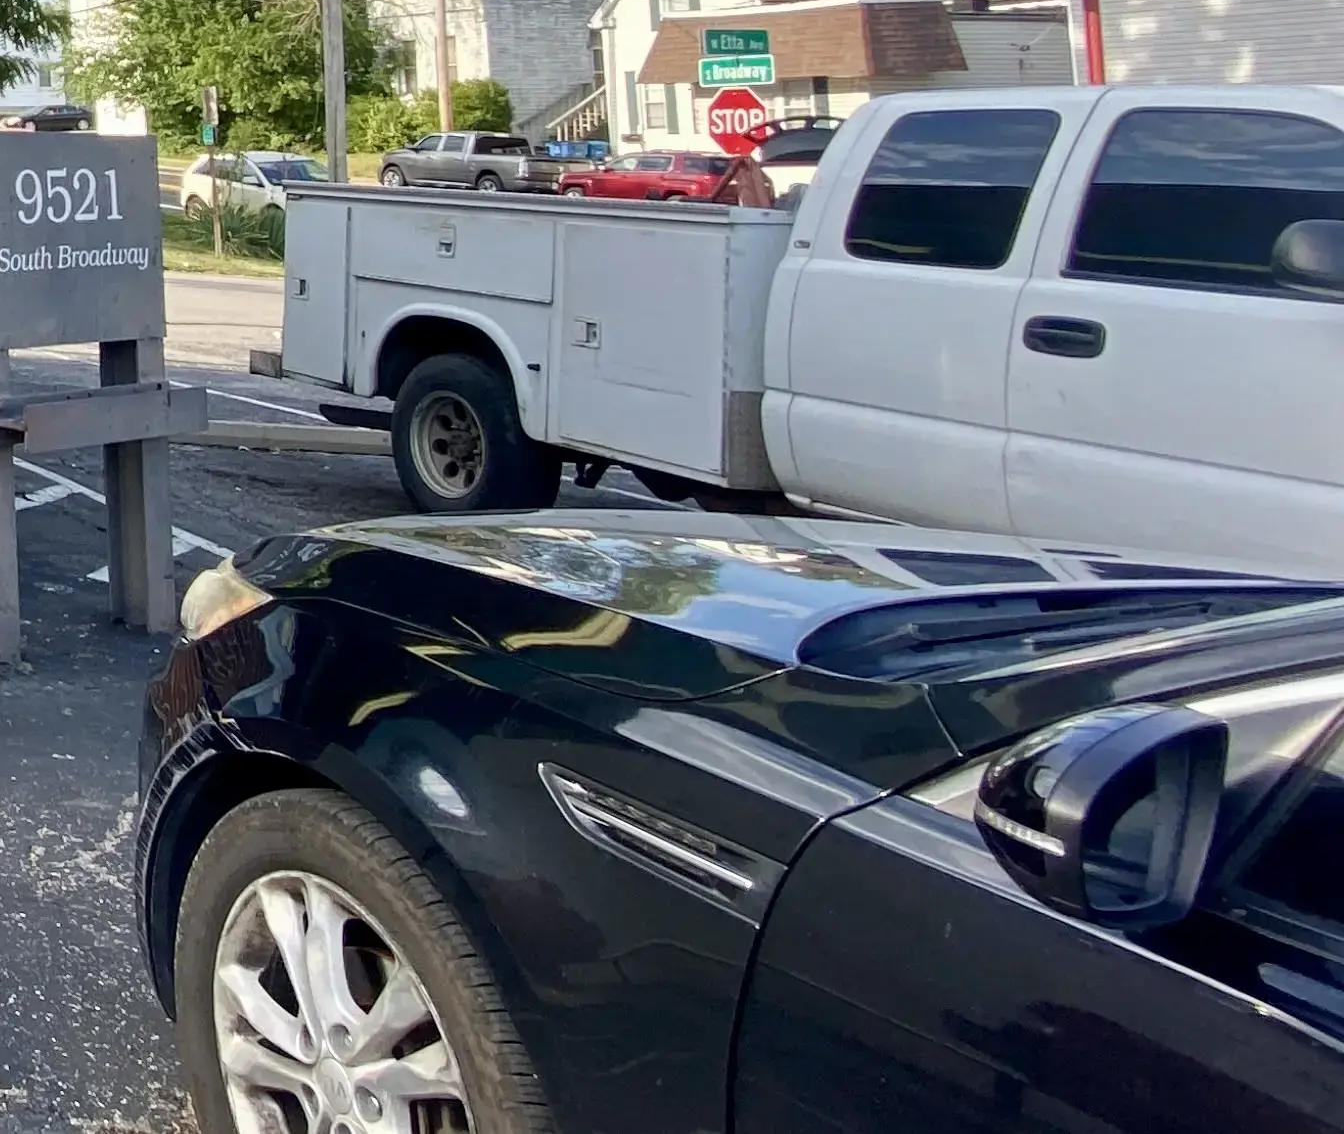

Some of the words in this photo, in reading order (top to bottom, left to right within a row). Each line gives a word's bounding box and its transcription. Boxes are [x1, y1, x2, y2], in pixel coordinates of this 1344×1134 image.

[720, 34, 744, 50] Etta
[712, 64, 767, 82] Broadway
[711, 108, 764, 134] STOP
[15, 168, 123, 224] 9521
[58, 243, 149, 270] Broadway
